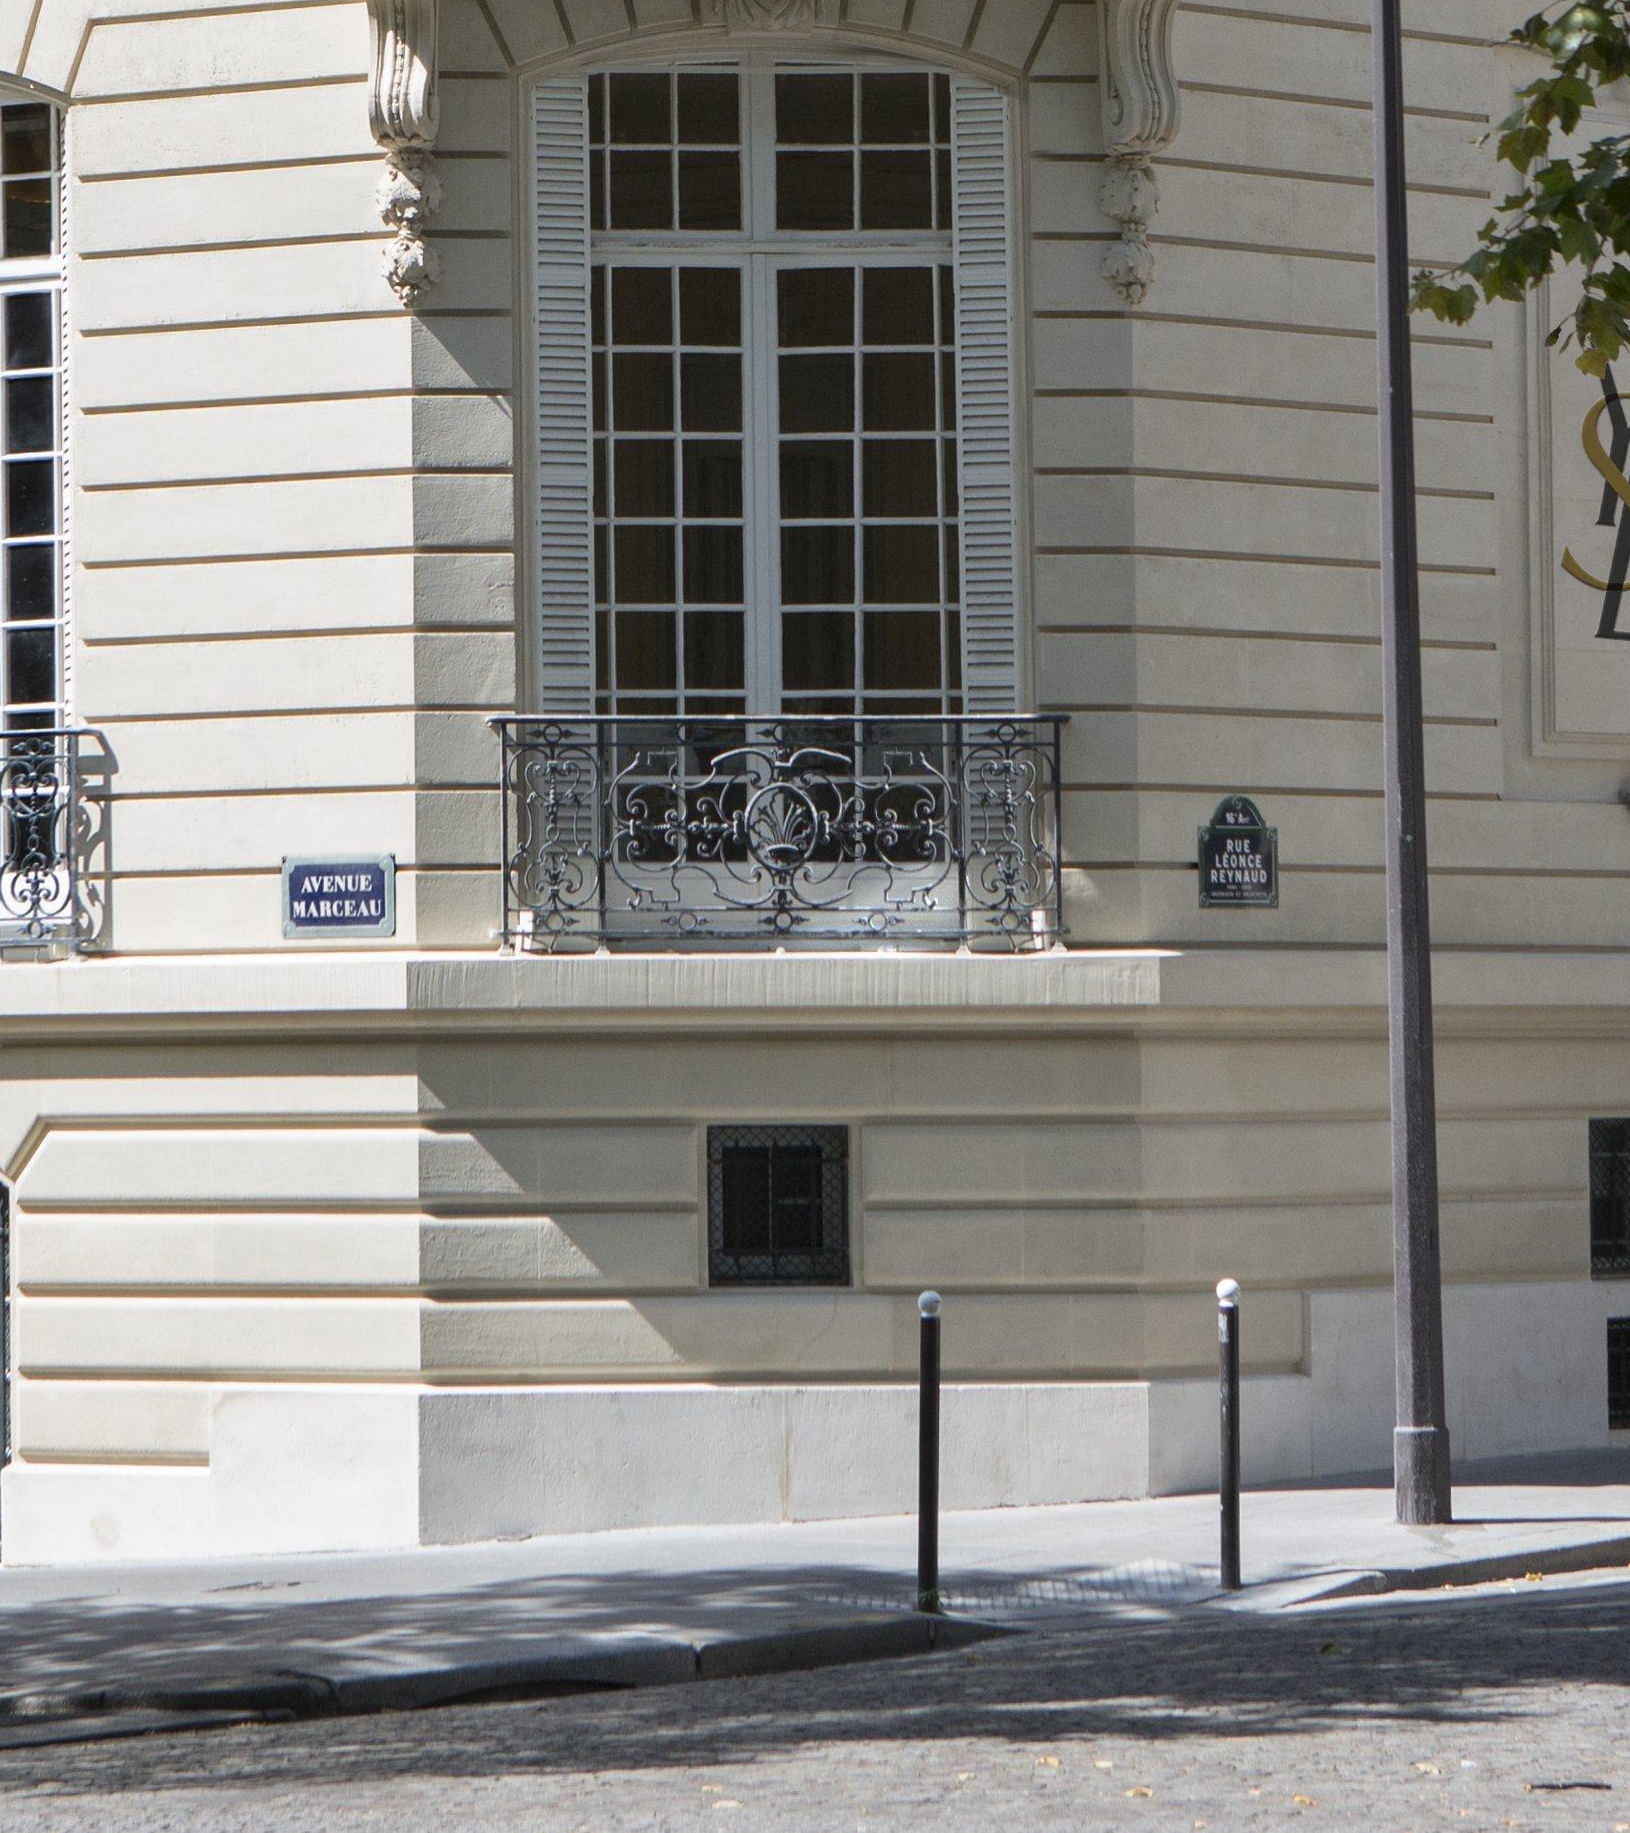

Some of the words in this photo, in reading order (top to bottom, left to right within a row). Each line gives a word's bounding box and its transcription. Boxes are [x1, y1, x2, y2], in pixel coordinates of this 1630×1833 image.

[1226, 839, 1251, 852] RUE
[1215, 851, 1262, 868] LÉONCE
[301, 874, 372, 893] AVENUE
[1210, 869, 1267, 883] REYNAUD
[293, 899, 382, 918] MARCEAU
